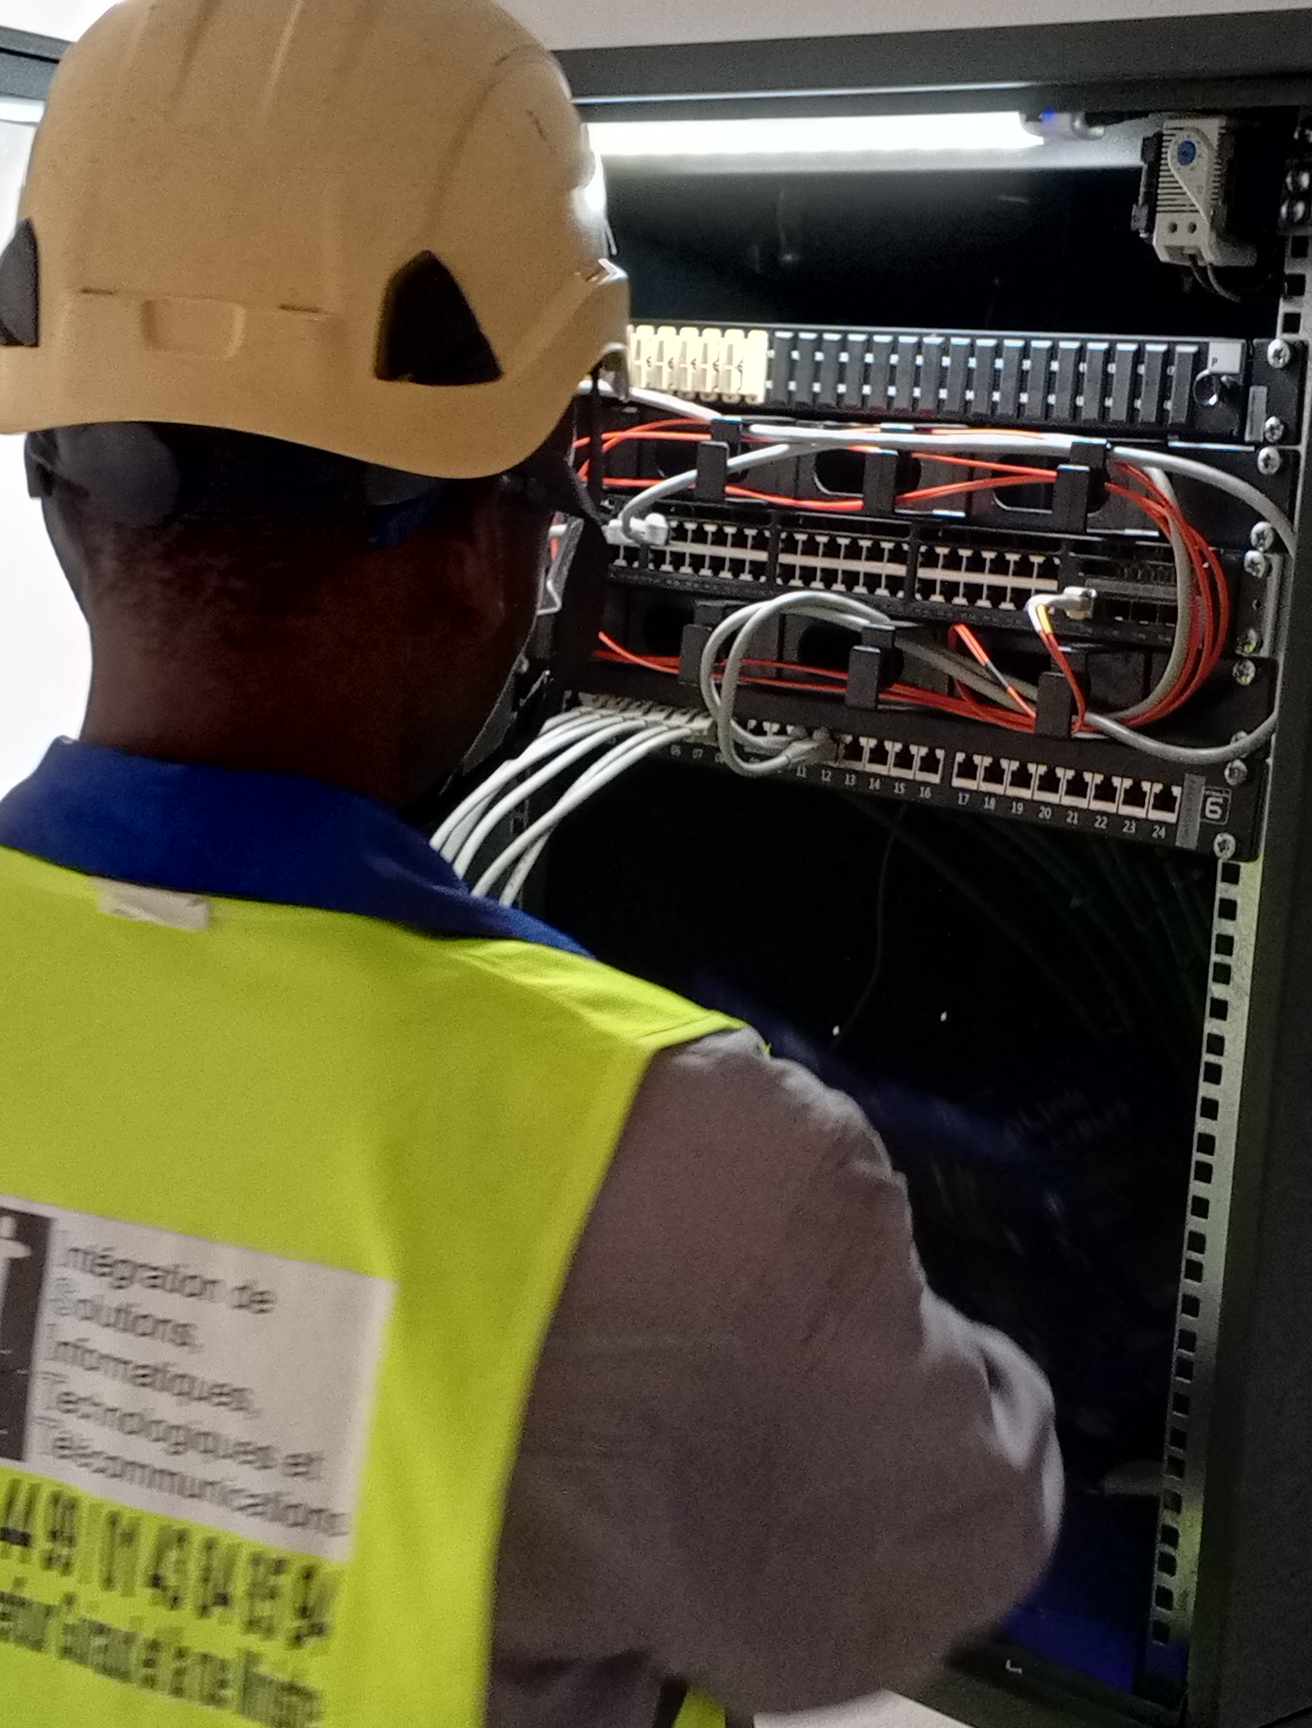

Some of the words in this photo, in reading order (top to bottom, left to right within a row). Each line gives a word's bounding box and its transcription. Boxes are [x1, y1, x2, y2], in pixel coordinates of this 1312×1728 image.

[795, 766, 807, 779] 11
[820, 769, 833, 782] 12
[844, 773, 857, 787] 13
[868, 778, 881, 791] 14
[893, 782, 906, 795] 15
[919, 786, 932, 799] 16
[957, 793, 970, 806] 17
[984, 797, 997, 810] 18
[1011, 801, 1024, 815] 19
[1038, 805, 1052, 820] 20
[1066, 810, 1079, 825] 21
[1093, 815, 1108, 829] 22
[1122, 820, 1136, 834] 23
[1151, 825, 1166, 839] 24
[1204, 796, 1224, 820] 6
[228, 1279, 279, 1315] de
[280, 1451, 324, 1482] et
